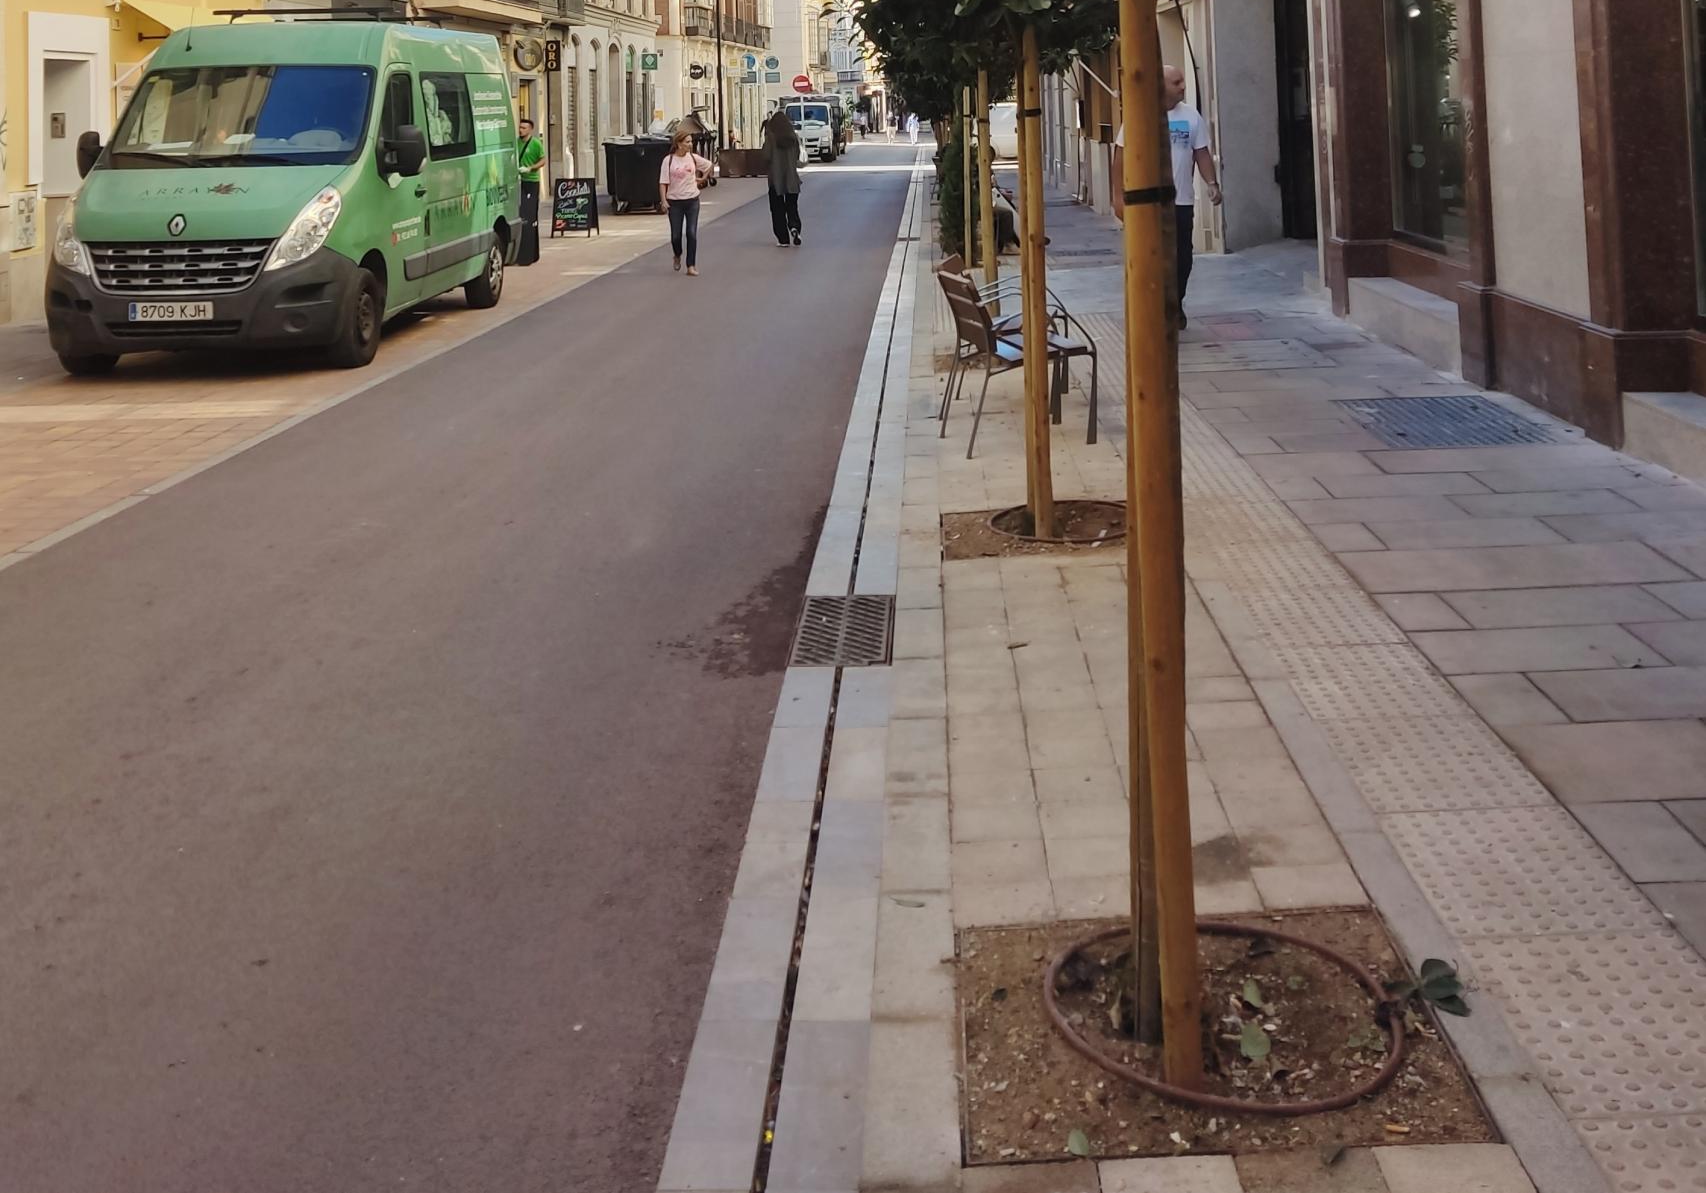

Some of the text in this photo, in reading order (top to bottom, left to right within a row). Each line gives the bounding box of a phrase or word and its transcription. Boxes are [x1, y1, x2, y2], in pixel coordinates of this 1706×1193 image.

[547, 42, 557, 69] ORO
[141, 304, 206, 319] 8709 KJH
